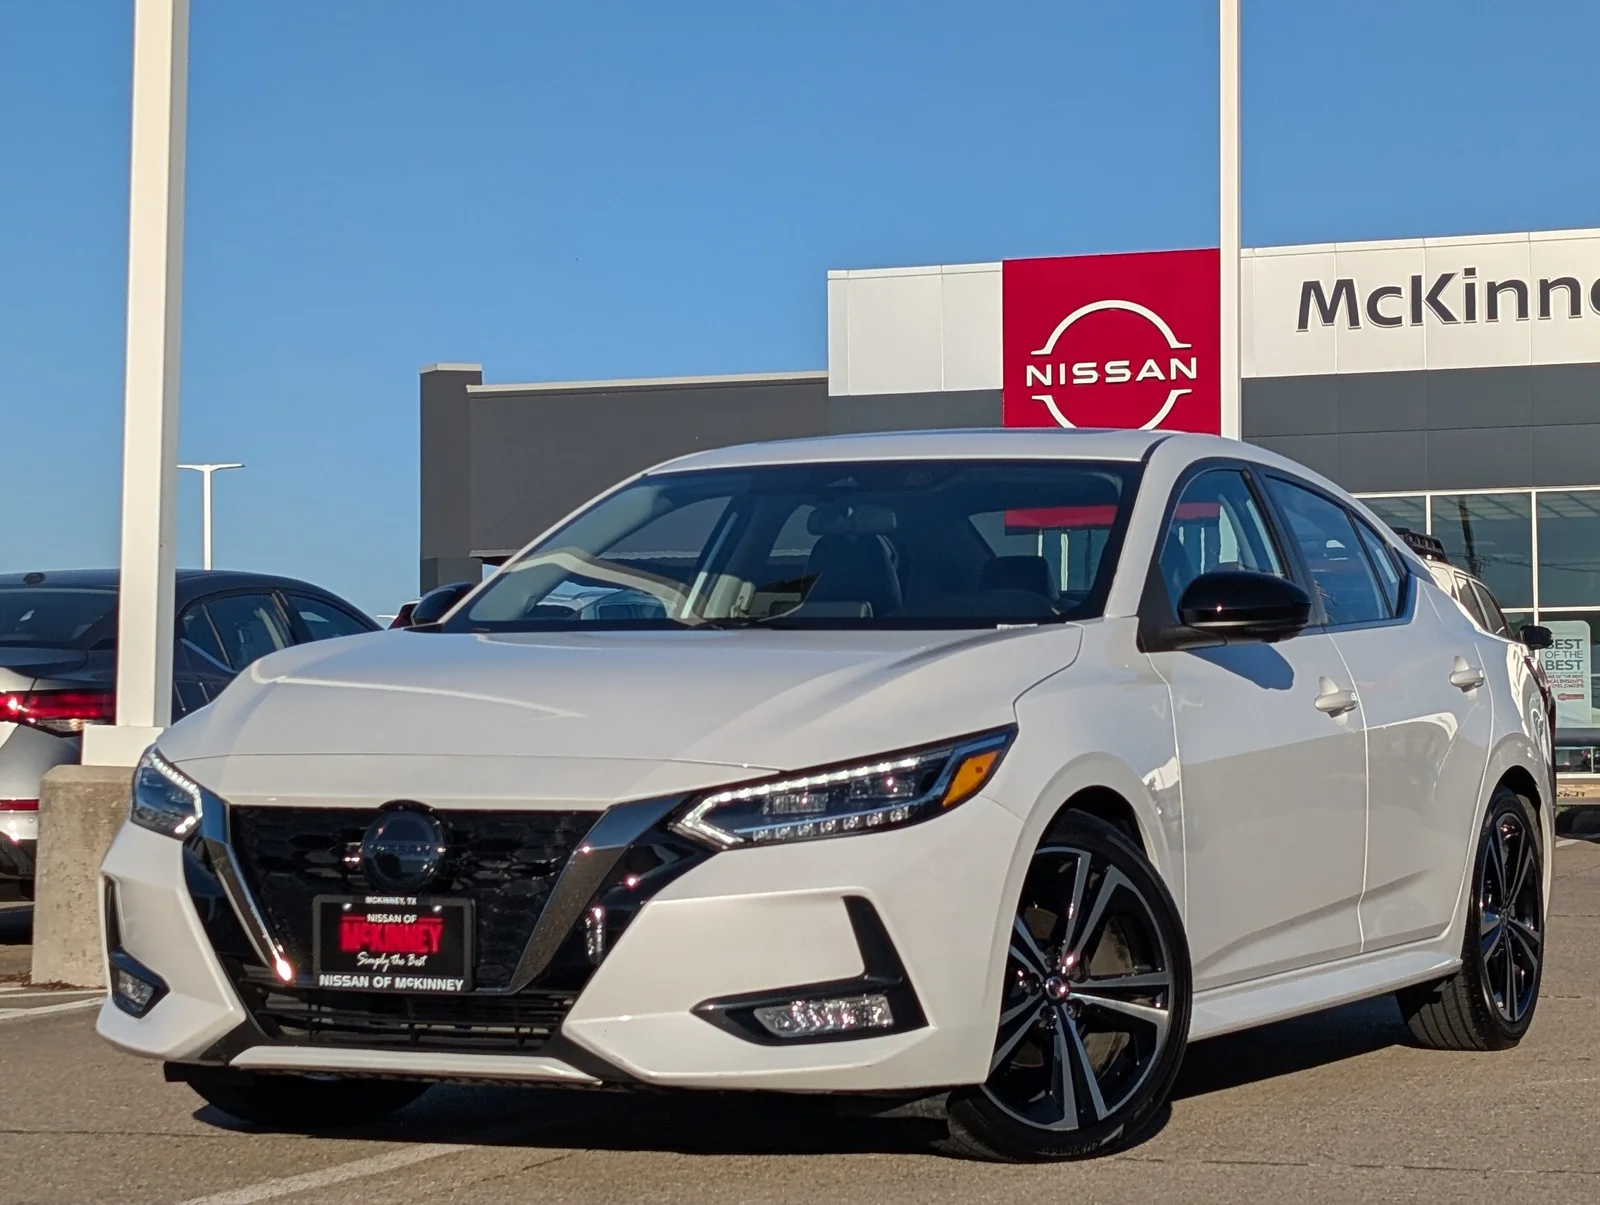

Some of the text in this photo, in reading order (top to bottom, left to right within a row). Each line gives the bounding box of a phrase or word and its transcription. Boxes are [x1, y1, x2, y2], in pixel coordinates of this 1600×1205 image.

[1297, 268, 1600, 331] McKinn
[1026, 357, 1197, 387] NISSAN
[1545, 650, 1583, 659] OF THE
[1545, 660, 1583, 670] BEST
[406, 897, 417, 905] TX
[367, 914, 417, 923] NISSAN OF
[357, 951, 389, 972] Simply
[407, 953, 428, 966] Best
[319, 974, 369, 987] NISSAN
[372, 976, 391, 988] OF
